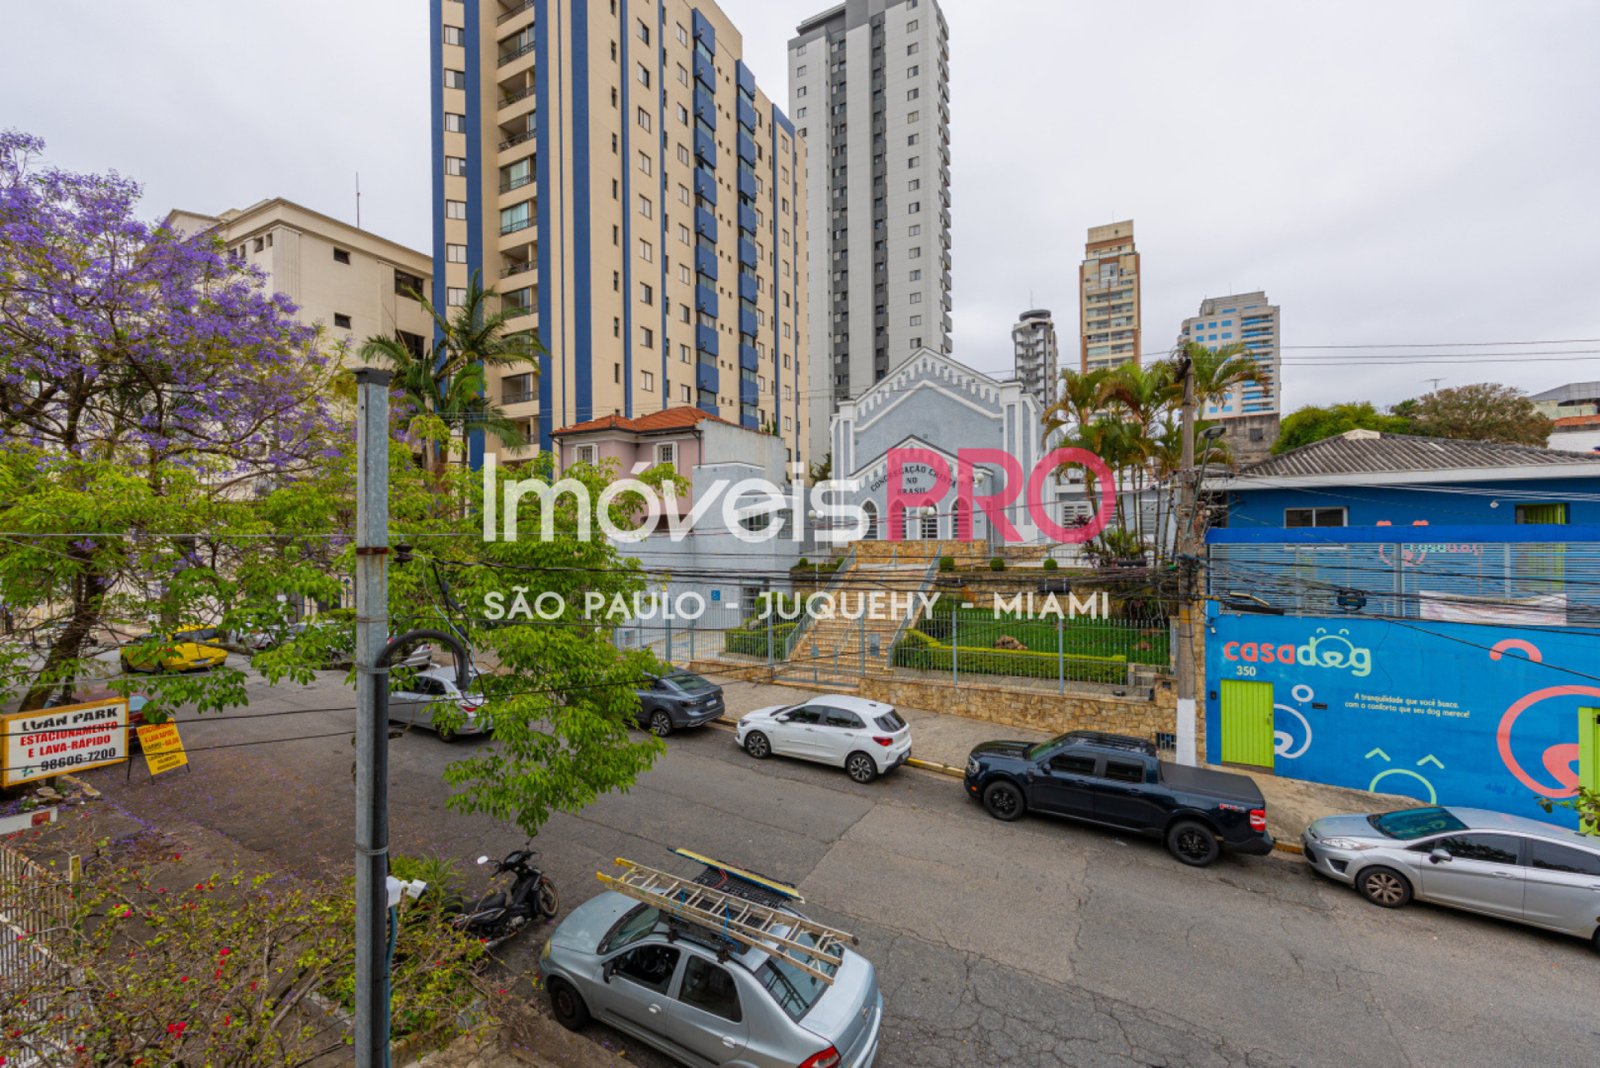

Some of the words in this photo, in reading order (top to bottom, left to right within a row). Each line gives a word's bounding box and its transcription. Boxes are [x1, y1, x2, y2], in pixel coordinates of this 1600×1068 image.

[906, 477, 918, 485] NO
[897, 487, 928, 497] BRASIL
[1236, 665, 1257, 677] 350
[1420, 698, 1435, 706] você
[72, 706, 118, 723] PARK
[1367, 703, 1397, 711] conforto
[1399, 706, 1411, 714] que
[1413, 707, 1425, 715] seu
[1426, 708, 1441, 717] dog
[20, 720, 118, 747] ESTACIONAMENTO
[28, 748, 34, 758] E
[39, 734, 111, 756] LAVA-RÁPIDO
[40, 747, 116, 772] 98606-7200
